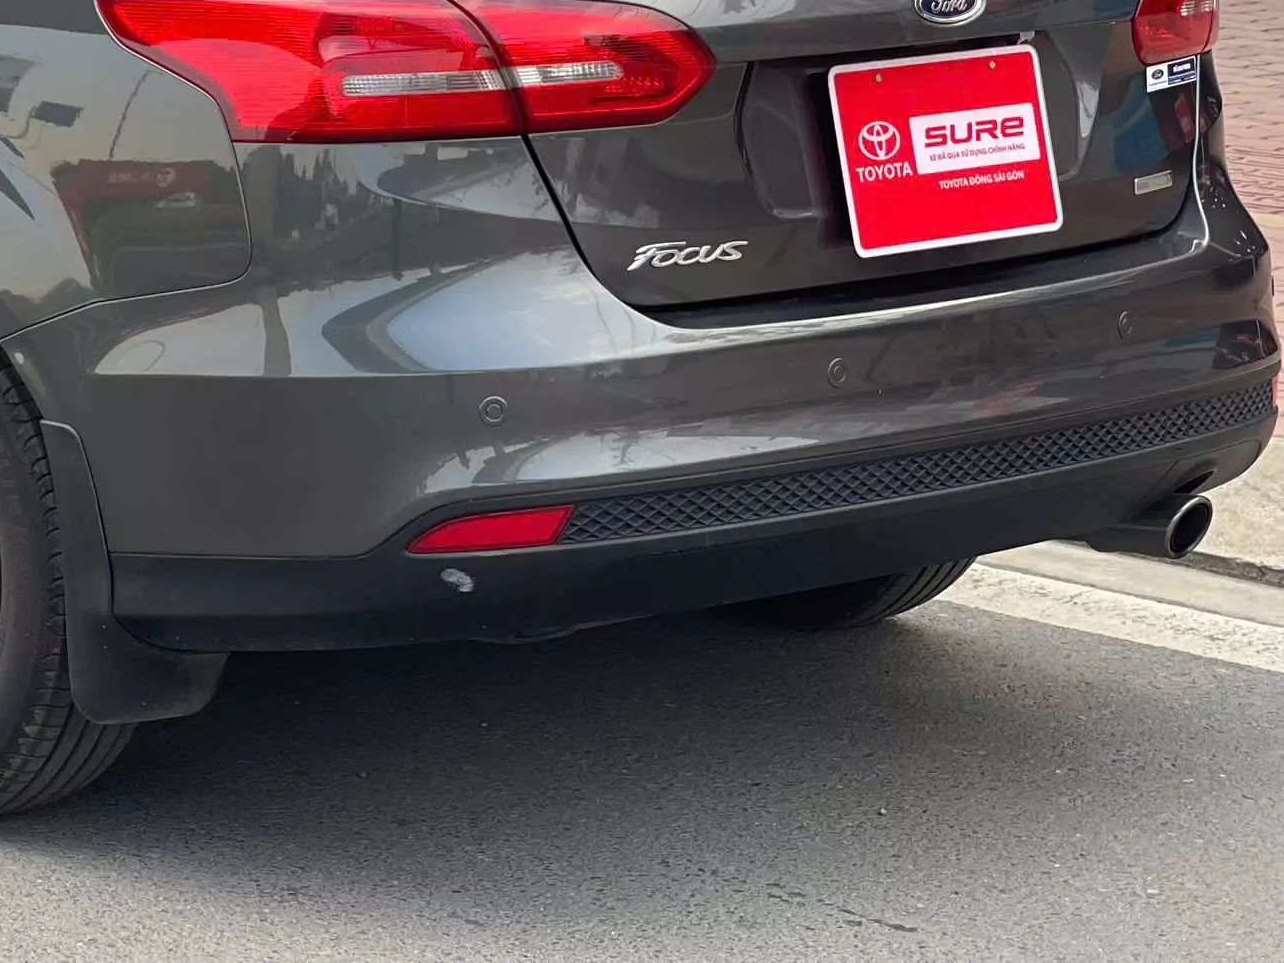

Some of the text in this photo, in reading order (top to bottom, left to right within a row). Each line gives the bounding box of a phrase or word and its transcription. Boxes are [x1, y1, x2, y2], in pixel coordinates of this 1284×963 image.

[929, 153, 937, 161] XE
[938, 150, 946, 160] ĐÃ
[947, 151, 960, 159] QUA
[970, 147, 987, 158] DỤNG
[988, 143, 1007, 154] CHÍNH
[856, 161, 913, 183] TOYOTA
[939, 168, 1025, 190] TOYOTA ĐÔNG SÀI GÒN
